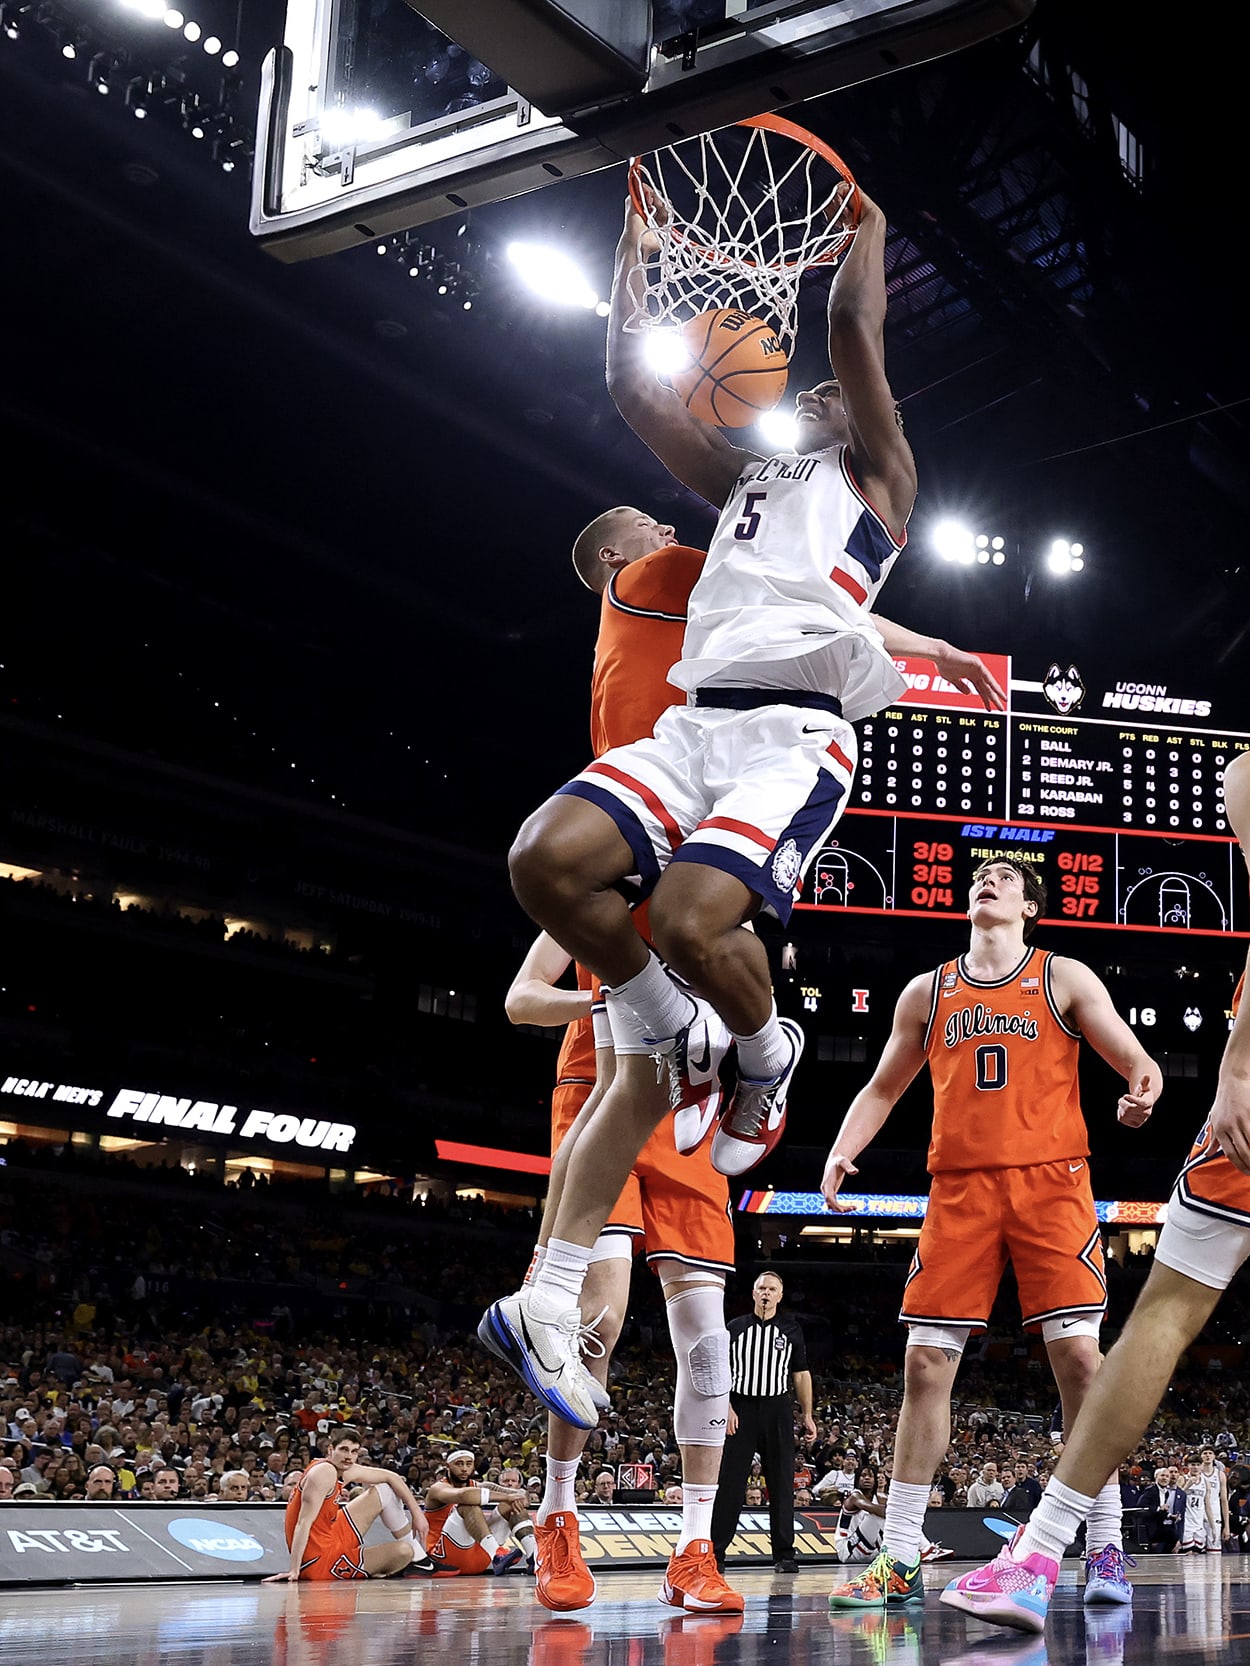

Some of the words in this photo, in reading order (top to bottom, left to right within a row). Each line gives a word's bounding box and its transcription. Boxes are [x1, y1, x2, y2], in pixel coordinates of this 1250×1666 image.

[733, 490, 768, 541] 5
[1116, 681, 1167, 697] UCONN
[1102, 691, 1212, 717] HUSKIES
[885, 711, 903, 720] REB
[911, 713, 928, 722] AST
[936, 715, 952, 724] STL
[959, 718, 976, 726] BLK
[984, 720, 1000, 728] FLS
[1019, 723, 1031, 731] ON
[1033, 725, 1049, 733] THE
[1050, 726, 1078, 735] COURT
[864, 725, 873, 735] 2
[888, 727, 898, 737] 0
[913, 729, 923, 739] 0
[938, 731, 947, 741] 0
[986, 735, 996, 745] 0
[1119, 733, 1136, 741] PTS
[863, 741, 872, 751] 2
[913, 745, 922, 755] 0
[937, 748, 947, 757] 0
[962, 750, 972, 759] 0
[986, 752, 996, 761] 0
[1040, 740, 1072, 752] BALL
[1123, 748, 1132, 758] 0
[1146, 749, 1155, 759] 0
[1170, 752, 1179, 761] 0
[1192, 754, 1202, 763] 0
[1215, 755, 1225, 765] 0
[863, 758, 872, 768] 0
[888, 760, 897, 770] 0
[913, 762, 922, 772] 0
[937, 764, 947, 774] 0
[962, 766, 971, 776] 0
[986, 768, 995, 778] 0
[1022, 755, 1031, 765] 2
[1040, 756, 1094, 770] DEMARY
[1095, 761, 1114, 772] JR.
[1123, 764, 1132, 774] 2
[1146, 766, 1155, 775] 4
[1170, 768, 1179, 777] 3
[1192, 770, 1202, 779] 0
[1215, 771, 1225, 781] 0
[862, 775, 871, 785] 3
[887, 777, 896, 787] 2
[912, 779, 922, 789] 0
[937, 781, 946, 791] 0
[961, 783, 971, 793] 0
[1022, 771, 1031, 781] 5
[1040, 772, 1075, 785] REED
[1076, 775, 1094, 786] JR.
[1123, 780, 1132, 789] 5
[1146, 782, 1155, 791] 4
[1170, 783, 1179, 793] 0
[1192, 786, 1202, 795] 0
[1215, 787, 1225, 797] 0
[862, 791, 871, 802] 0
[887, 793, 896, 804] 0
[912, 795, 921, 805] 0
[936, 797, 946, 807] 0
[961, 799, 971, 809] 0
[1022, 788, 1031, 798] 11
[1040, 789, 1103, 804] KARABAN
[1123, 796, 1132, 806] 0
[1146, 798, 1155, 808] 0
[1170, 800, 1179, 809] 0
[1192, 802, 1202, 811] 0
[1215, 804, 1225, 813] 0
[1018, 804, 1034, 815] 23
[1040, 805, 1076, 818] ROSS
[1123, 812, 1132, 822] 3
[1146, 814, 1155, 824] 0
[1170, 816, 1179, 826] 0
[1192, 818, 1202, 827] 0
[1215, 820, 1225, 829] 0
[999, 827, 1056, 842] HALF
[912, 841, 954, 862] 3/9
[970, 847, 1003, 860] FIELD
[1006, 850, 1045, 862] GOALS
[1057, 852, 1103, 873] 6/12
[912, 864, 953, 885] 3/5
[1061, 875, 1100, 895] 3/5
[911, 886, 954, 908] 0/4
[1062, 897, 1099, 917] 3/7
[800, 987, 822, 997] TOL
[803, 997, 817, 1012] 4
[944, 1003, 1039, 1049] Illinois
[1129, 1007, 1157, 1026] 16
[974, 1043, 1009, 1091] 0
[52, 1084, 104, 1106] MEN'S
[107, 1088, 238, 1135] FINAL
[239, 1108, 357, 1152] FOUR
[6, 1529, 131, 1554] AT&T
[190, 1537, 264, 1552] NCAA
